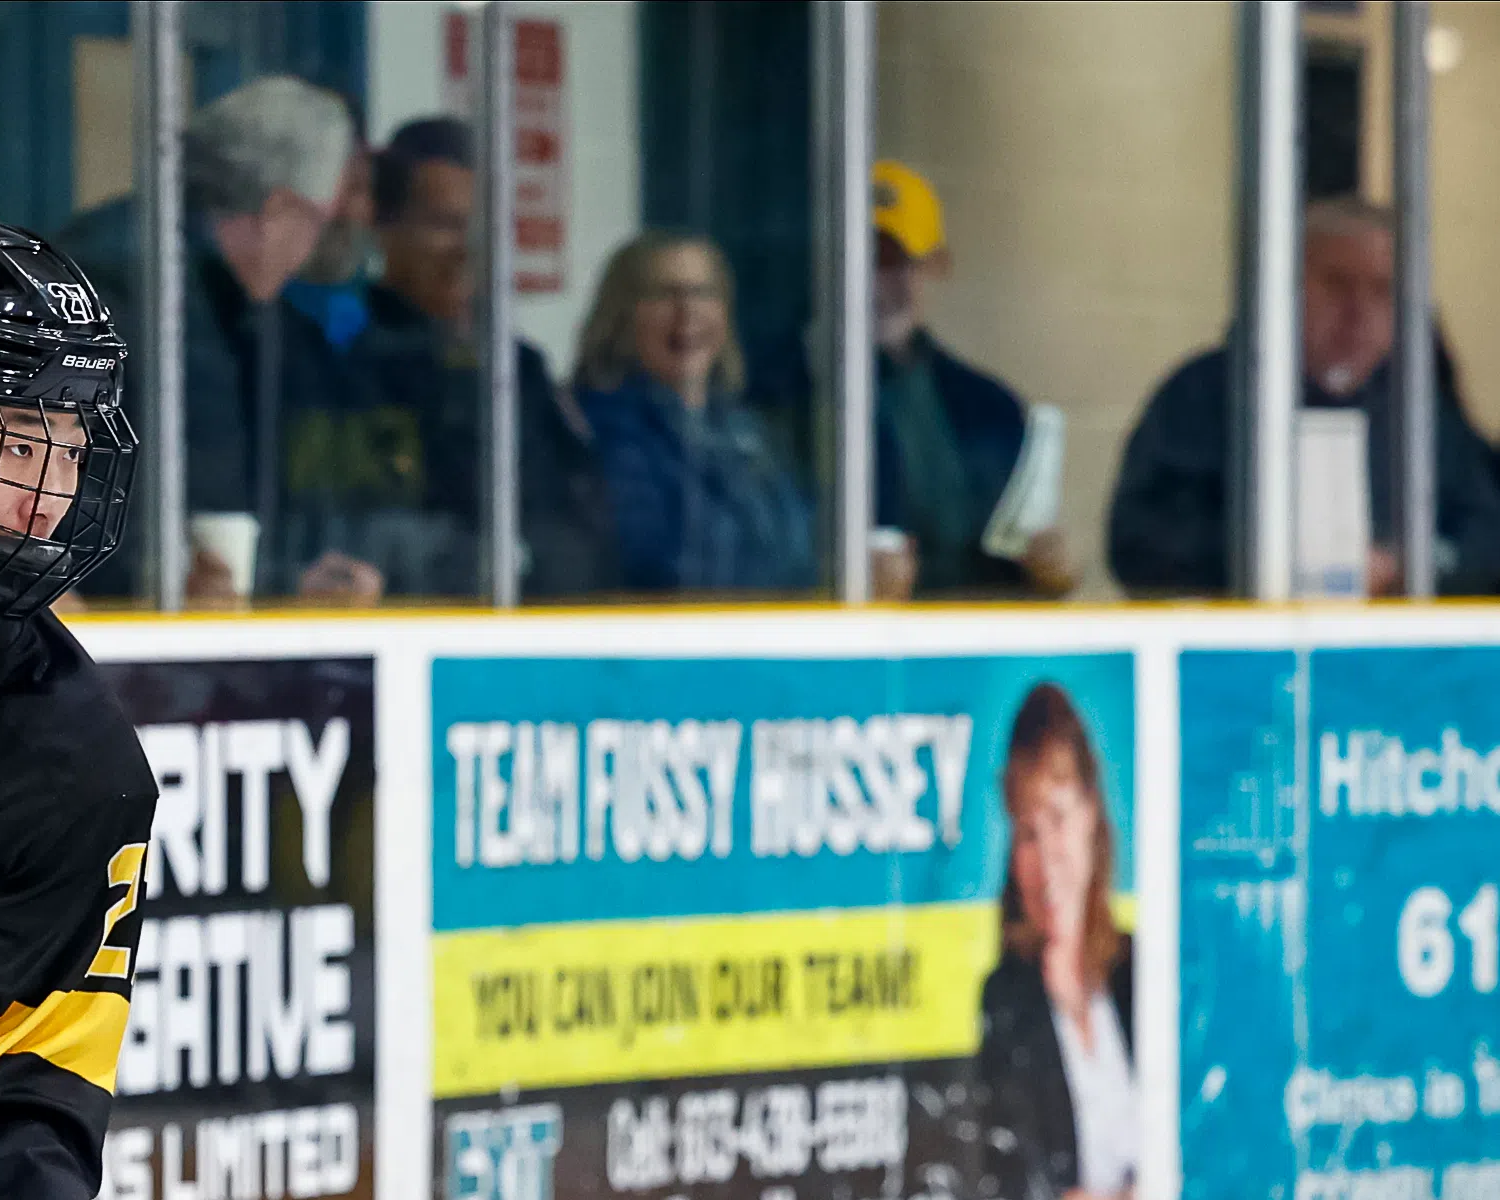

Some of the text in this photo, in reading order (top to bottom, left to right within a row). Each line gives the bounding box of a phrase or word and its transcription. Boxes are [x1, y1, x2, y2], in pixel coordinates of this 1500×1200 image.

[61, 354, 116, 371] BAUER
[134, 716, 351, 900] RITY
[446, 720, 580, 869] TEAM
[471, 969, 536, 1040] YOU
[710, 955, 788, 1023] OUR
